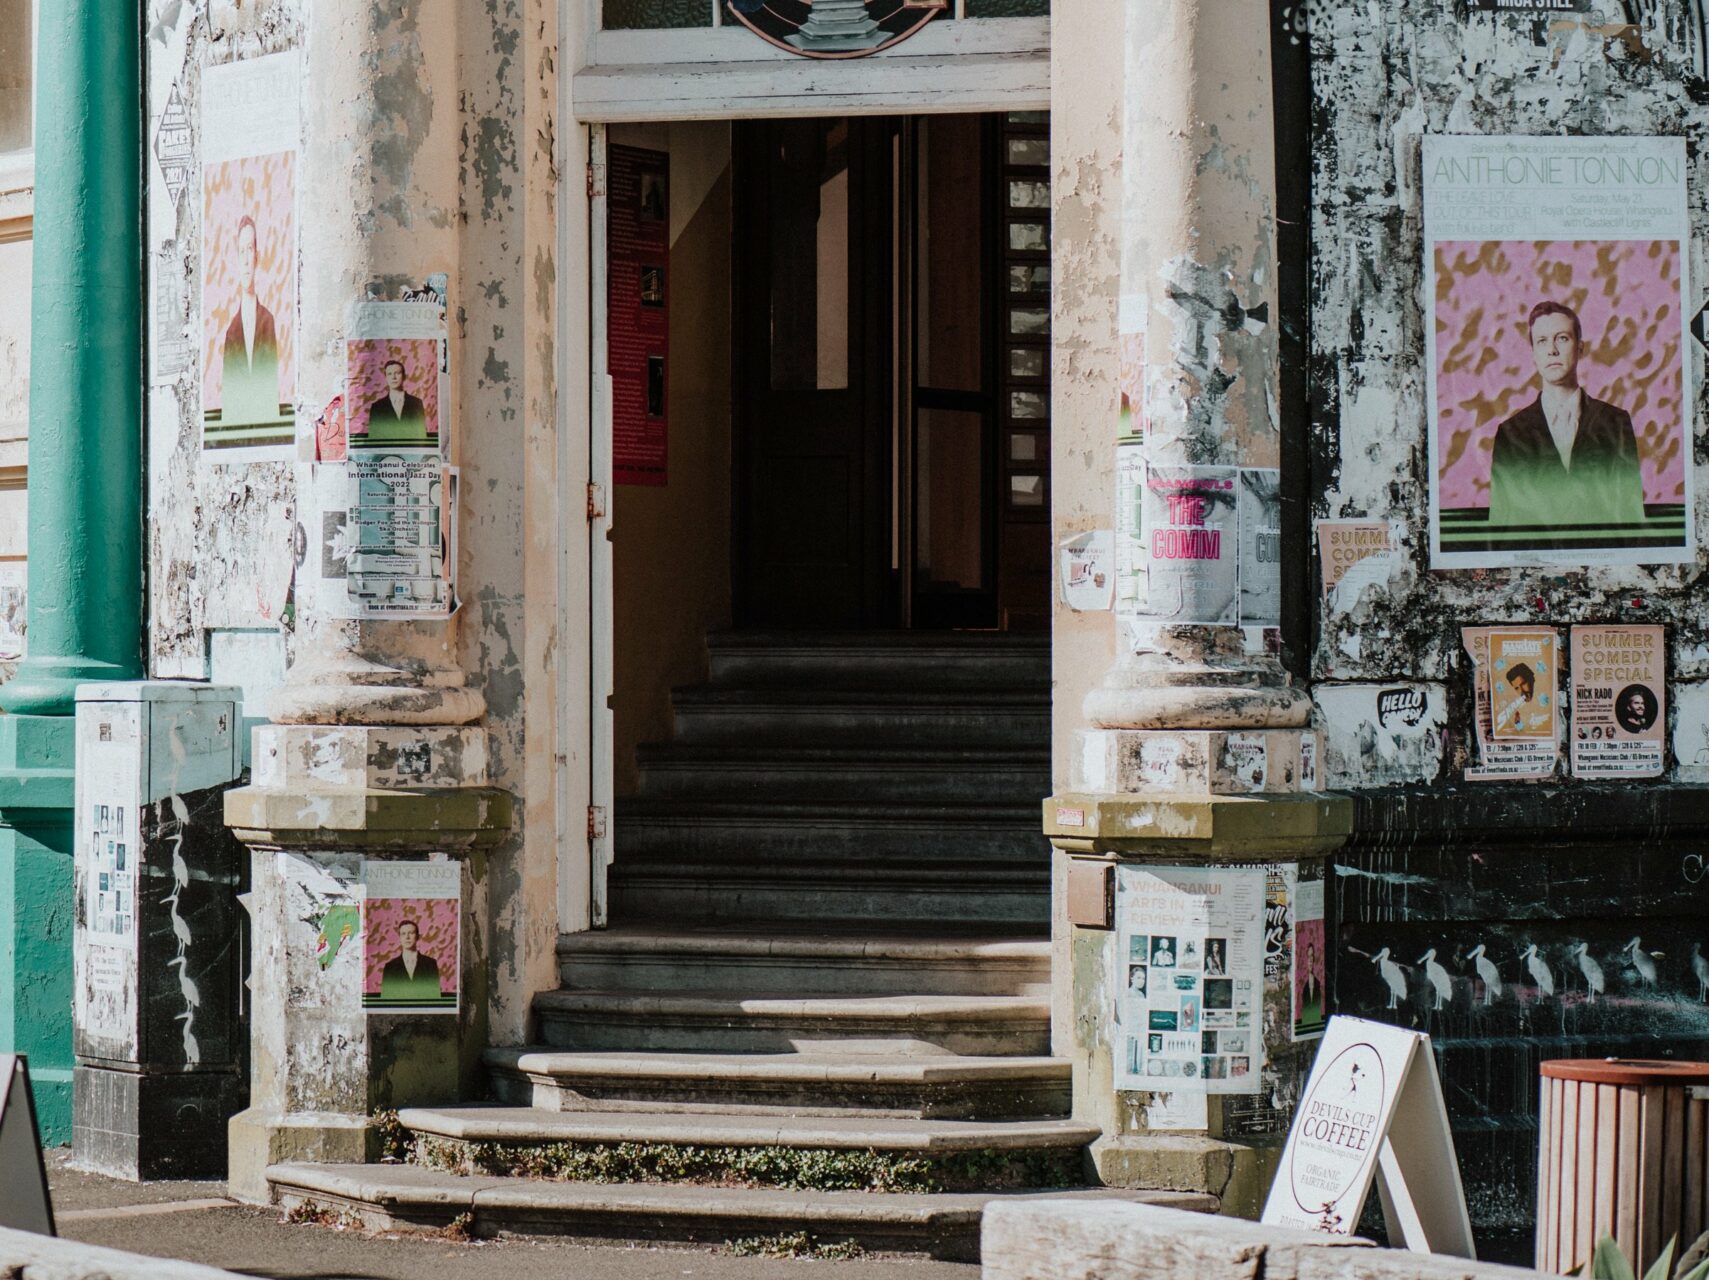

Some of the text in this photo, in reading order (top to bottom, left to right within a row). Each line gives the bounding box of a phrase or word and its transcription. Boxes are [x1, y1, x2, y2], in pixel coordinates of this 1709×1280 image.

[1432, 156, 1679, 185] ANTHONIE TONNON
[348, 471, 441, 480] International Jazz Day
[1167, 496, 1207, 526] THE
[1151, 529, 1220, 560] COMM
[1582, 633, 1655, 649] SUMMER
[1582, 650, 1654, 666] COMEDY
[1583, 667, 1653, 682] SPECIAL
[1381, 691, 1422, 712] HELLO
[1576, 687, 1613, 699] NICK RADO
[1131, 880, 1222, 895] WHANGANUI
[1130, 897, 1166, 910] ARTS
[1170, 899, 1184, 910] IN
[1130, 913, 1185, 926] REVIEW
[1310, 1101, 1376, 1129] DEVILS CUP
[1303, 1116, 1370, 1151] COFFEE
[1306, 1163, 1342, 1181] ORGANIC
[1300, 1175, 1341, 1193] FAIRTRADE
